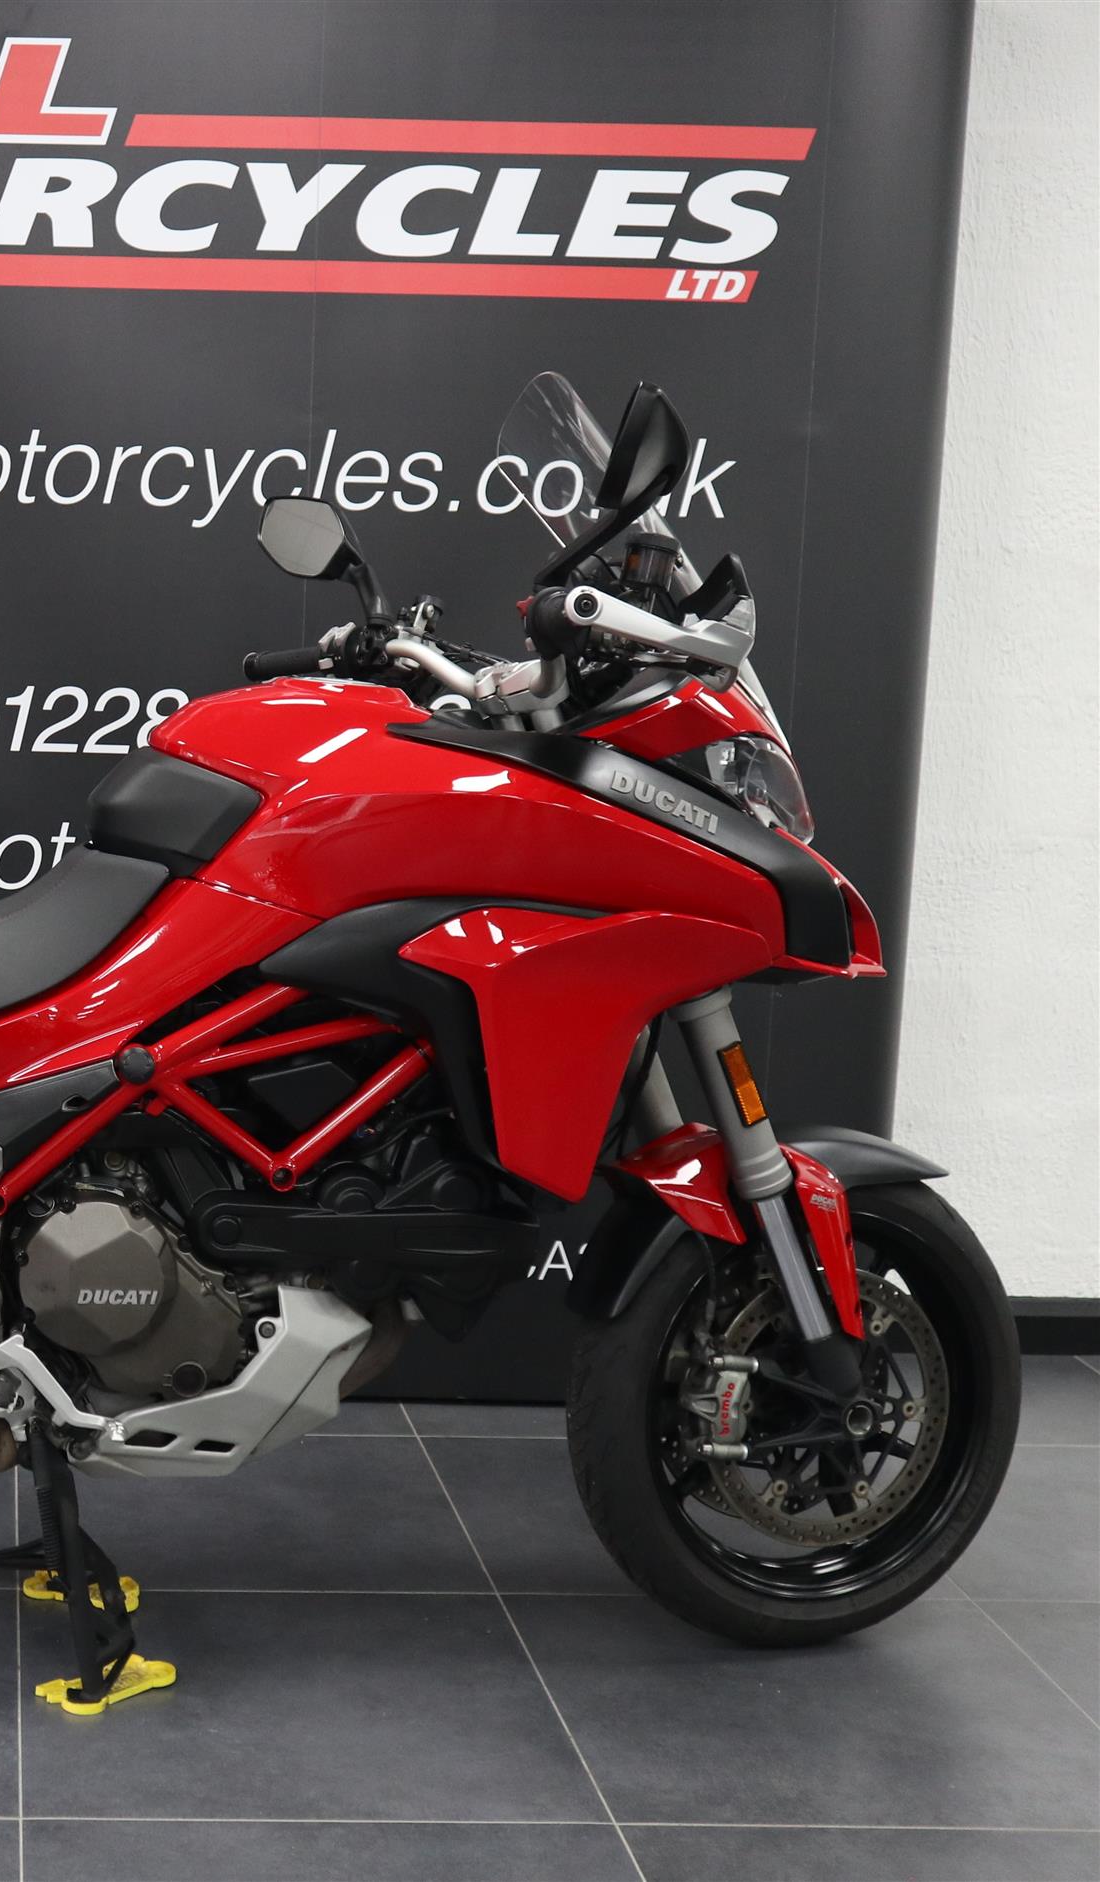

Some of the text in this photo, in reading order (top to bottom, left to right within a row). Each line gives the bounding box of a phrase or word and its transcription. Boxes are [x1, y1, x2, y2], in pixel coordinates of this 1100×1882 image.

[665, 269, 746, 300] LTD
[611, 770, 718, 834] DUCATI
[77, 1289, 158, 1305] DUCATI
